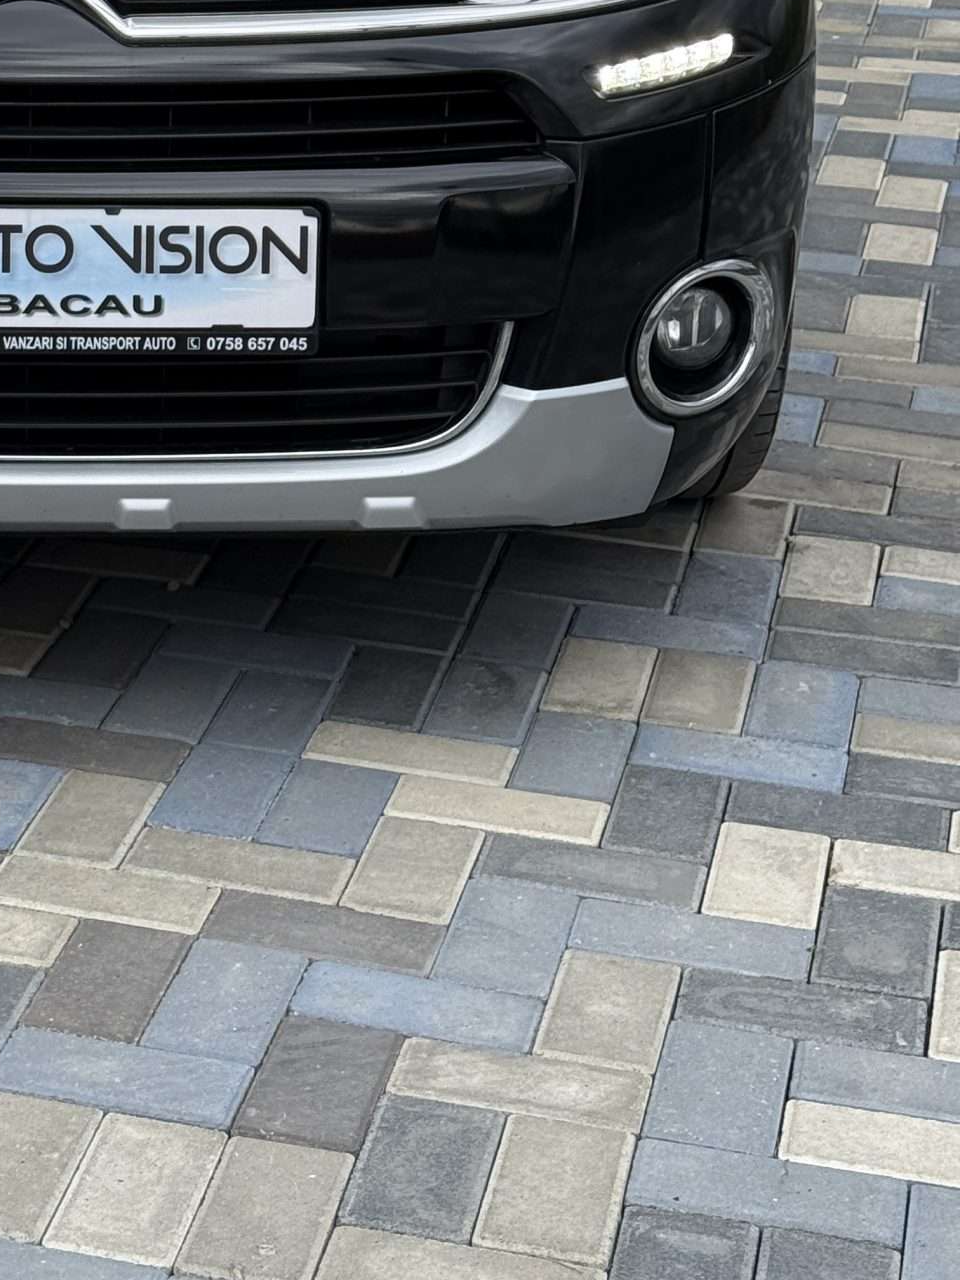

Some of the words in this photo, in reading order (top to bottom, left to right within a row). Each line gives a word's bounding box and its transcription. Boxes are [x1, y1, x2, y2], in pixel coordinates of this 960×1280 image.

[91, 224, 309, 275] VISION
[2, 335, 54, 350] VANZARI
[55, 335, 67, 350] SI
[69, 336, 141, 350] TRANSPORT
[143, 336, 176, 350] AUTO
[206, 336, 243, 351] 0758
[247, 336, 276, 351] 657
[279, 336, 308, 351] 045
